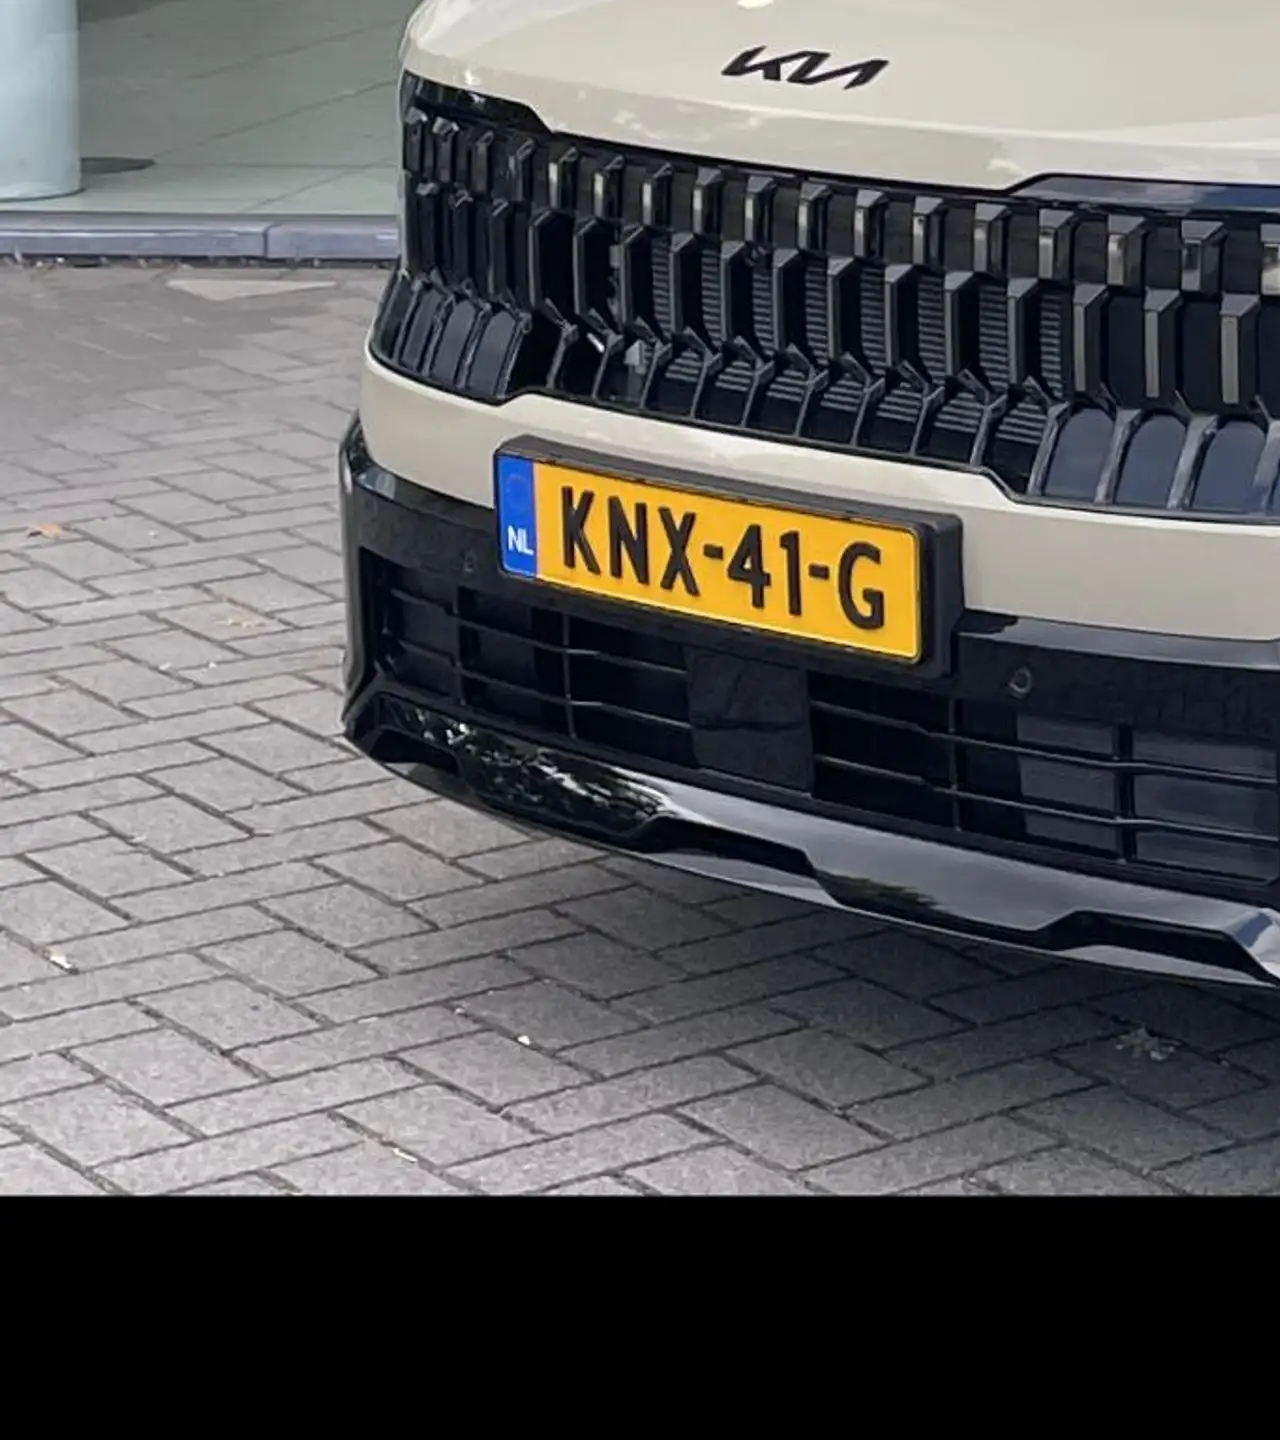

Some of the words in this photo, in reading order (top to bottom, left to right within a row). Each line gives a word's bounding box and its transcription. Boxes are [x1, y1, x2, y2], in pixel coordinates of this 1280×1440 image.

[721, 45, 890, 90] KIA
[507, 525, 534, 556] NL
[561, 486, 885, 631] KNX-41-G
